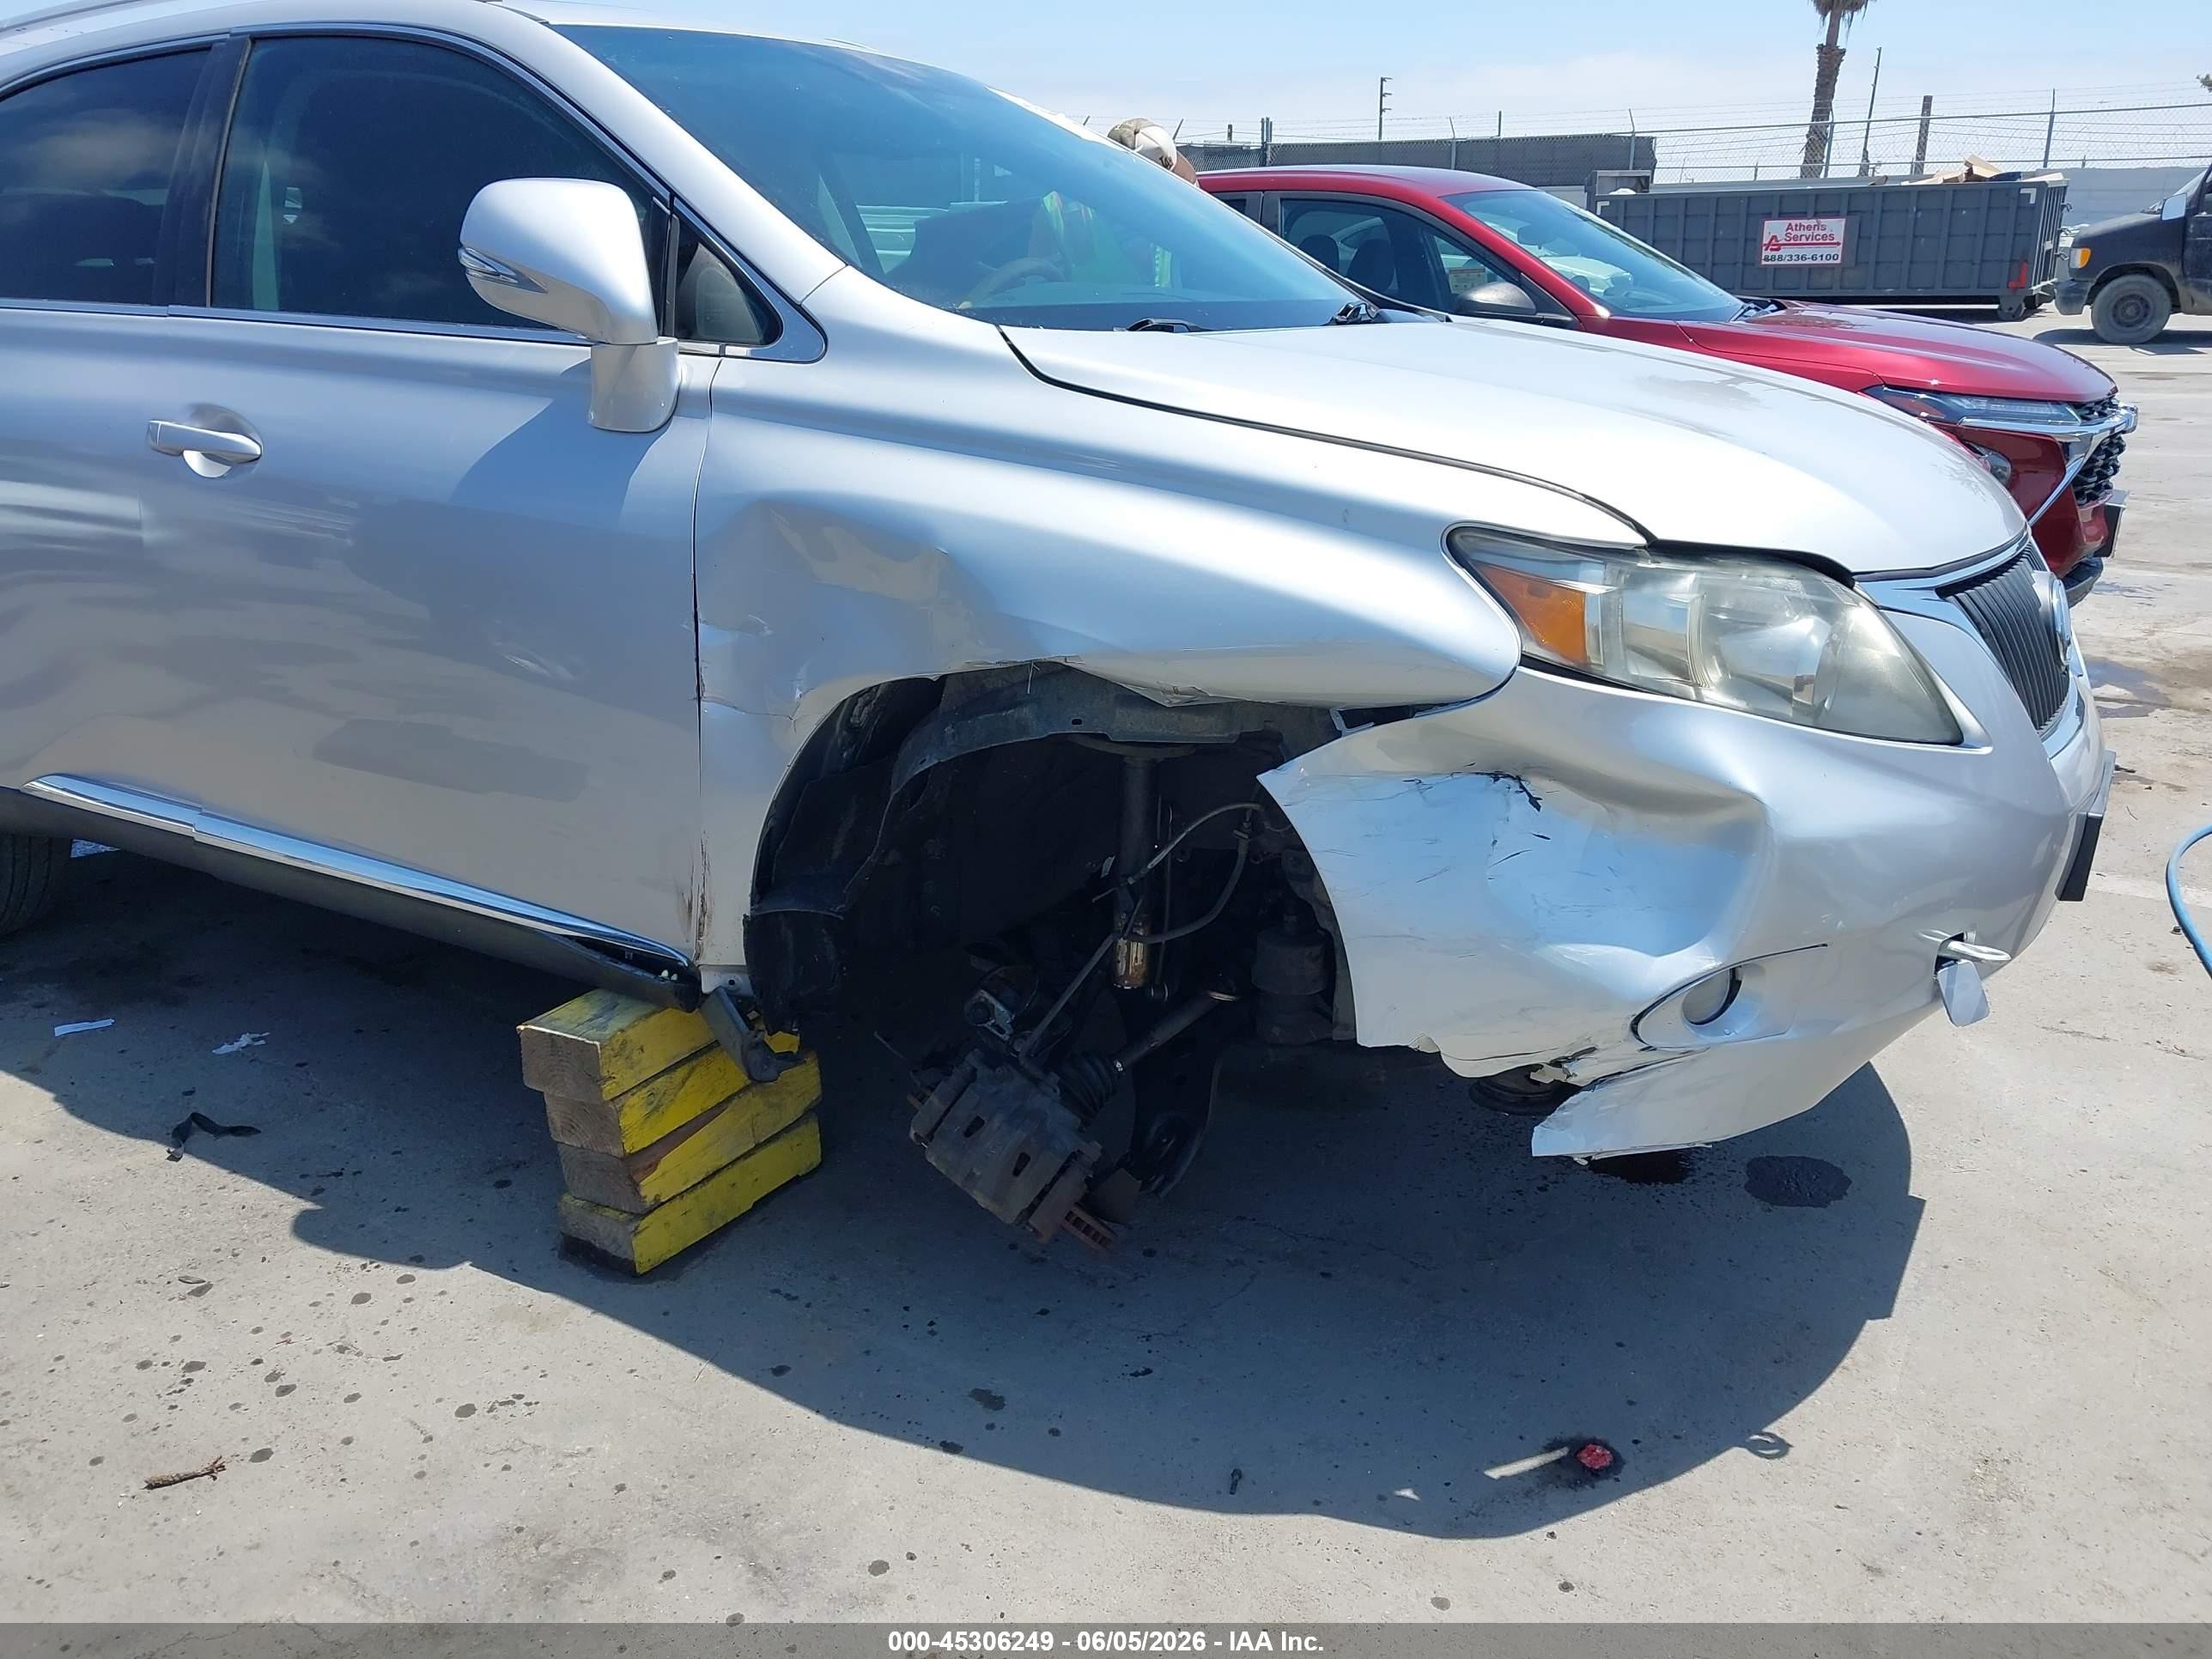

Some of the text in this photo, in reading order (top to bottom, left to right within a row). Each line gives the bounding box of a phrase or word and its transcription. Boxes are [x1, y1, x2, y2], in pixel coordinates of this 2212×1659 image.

[1785, 222, 1827, 232] Athens
[1784, 232, 1835, 242] Services
[1763, 253, 1839, 262] 888/336-6100
